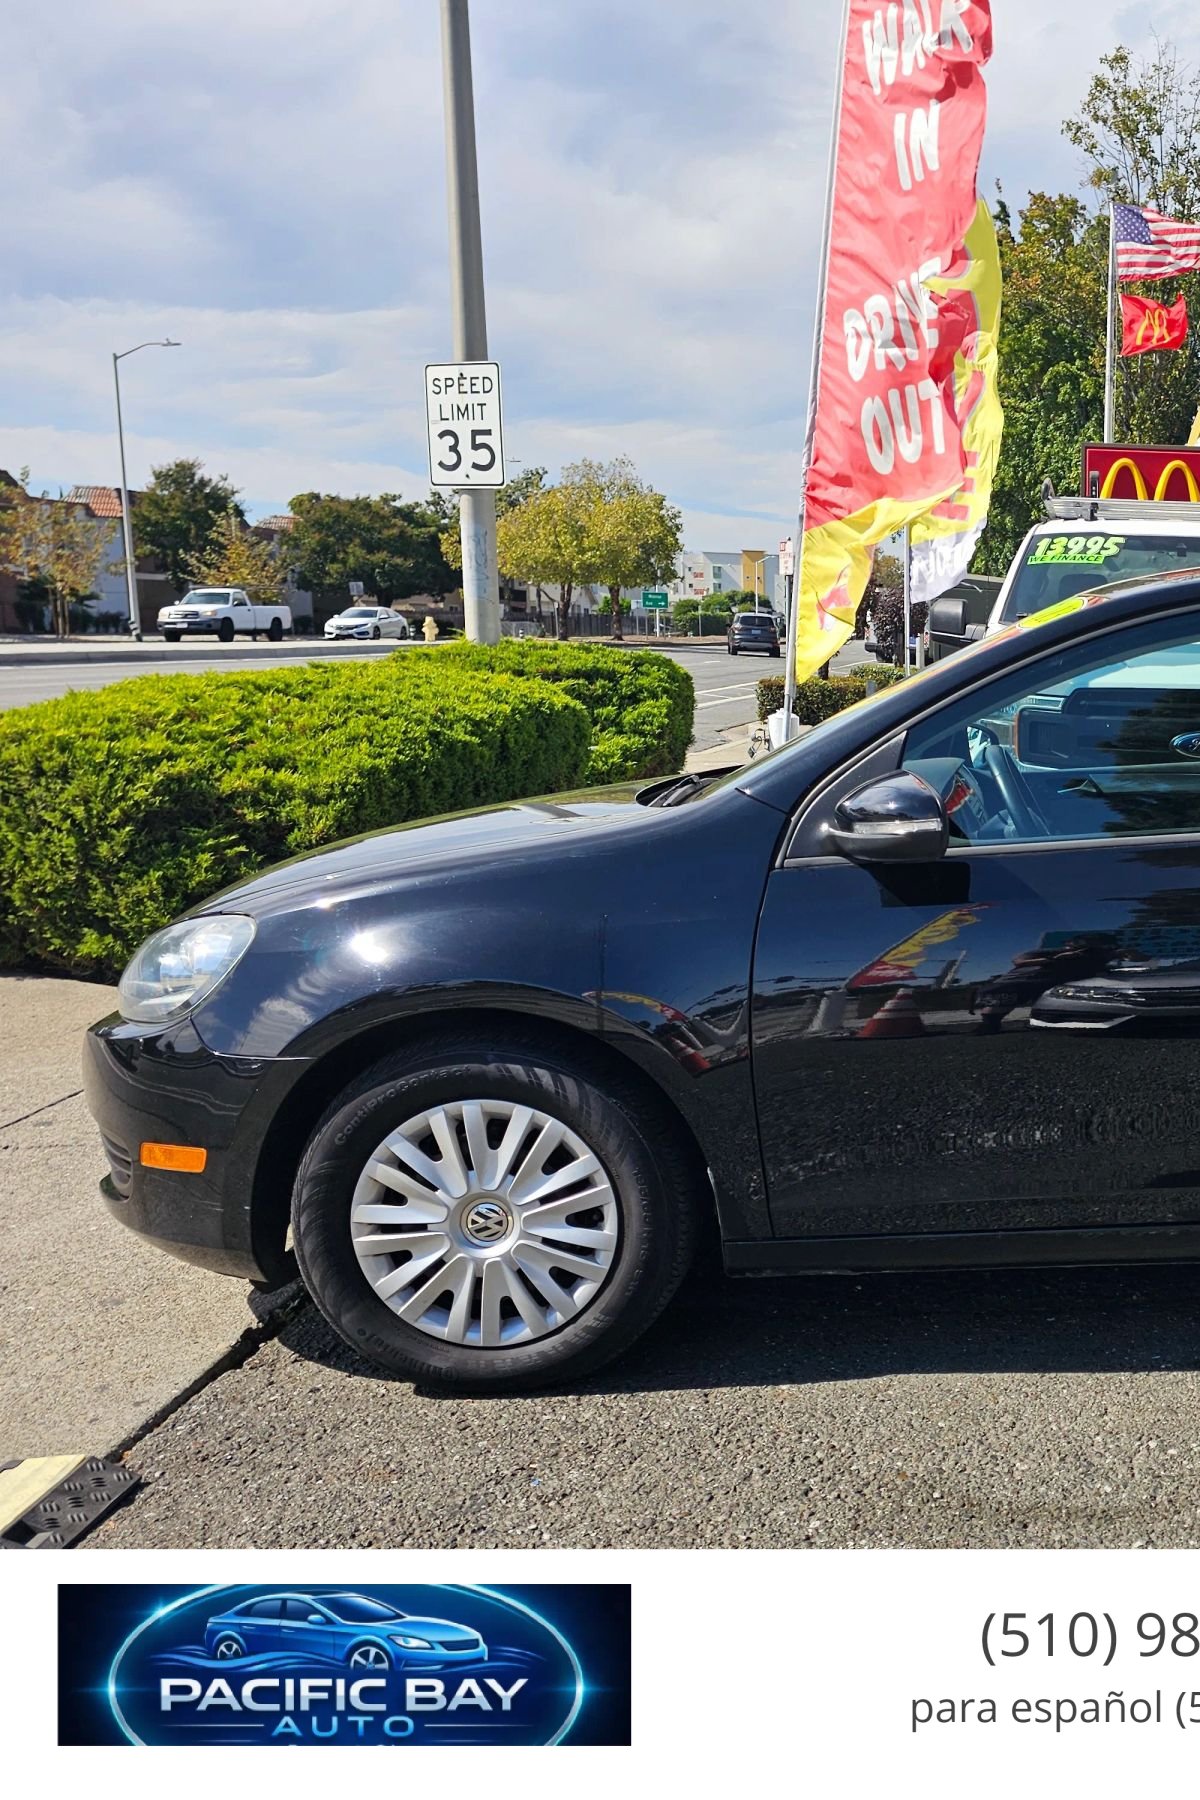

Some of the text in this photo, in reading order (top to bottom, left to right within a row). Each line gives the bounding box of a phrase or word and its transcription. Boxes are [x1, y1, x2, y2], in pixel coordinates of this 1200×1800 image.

[862, 0, 973, 95] WALK
[893, 98, 941, 191] IN
[843, 257, 941, 382] DRIVE
[432, 376, 493, 395] SPEED
[439, 403, 486, 421] LIMIT
[861, 377, 946, 476] OUT
[437, 429, 496, 472] 35
[1035, 536, 1126, 557] 13995
[1051, 554, 1102, 562] FINANCE
